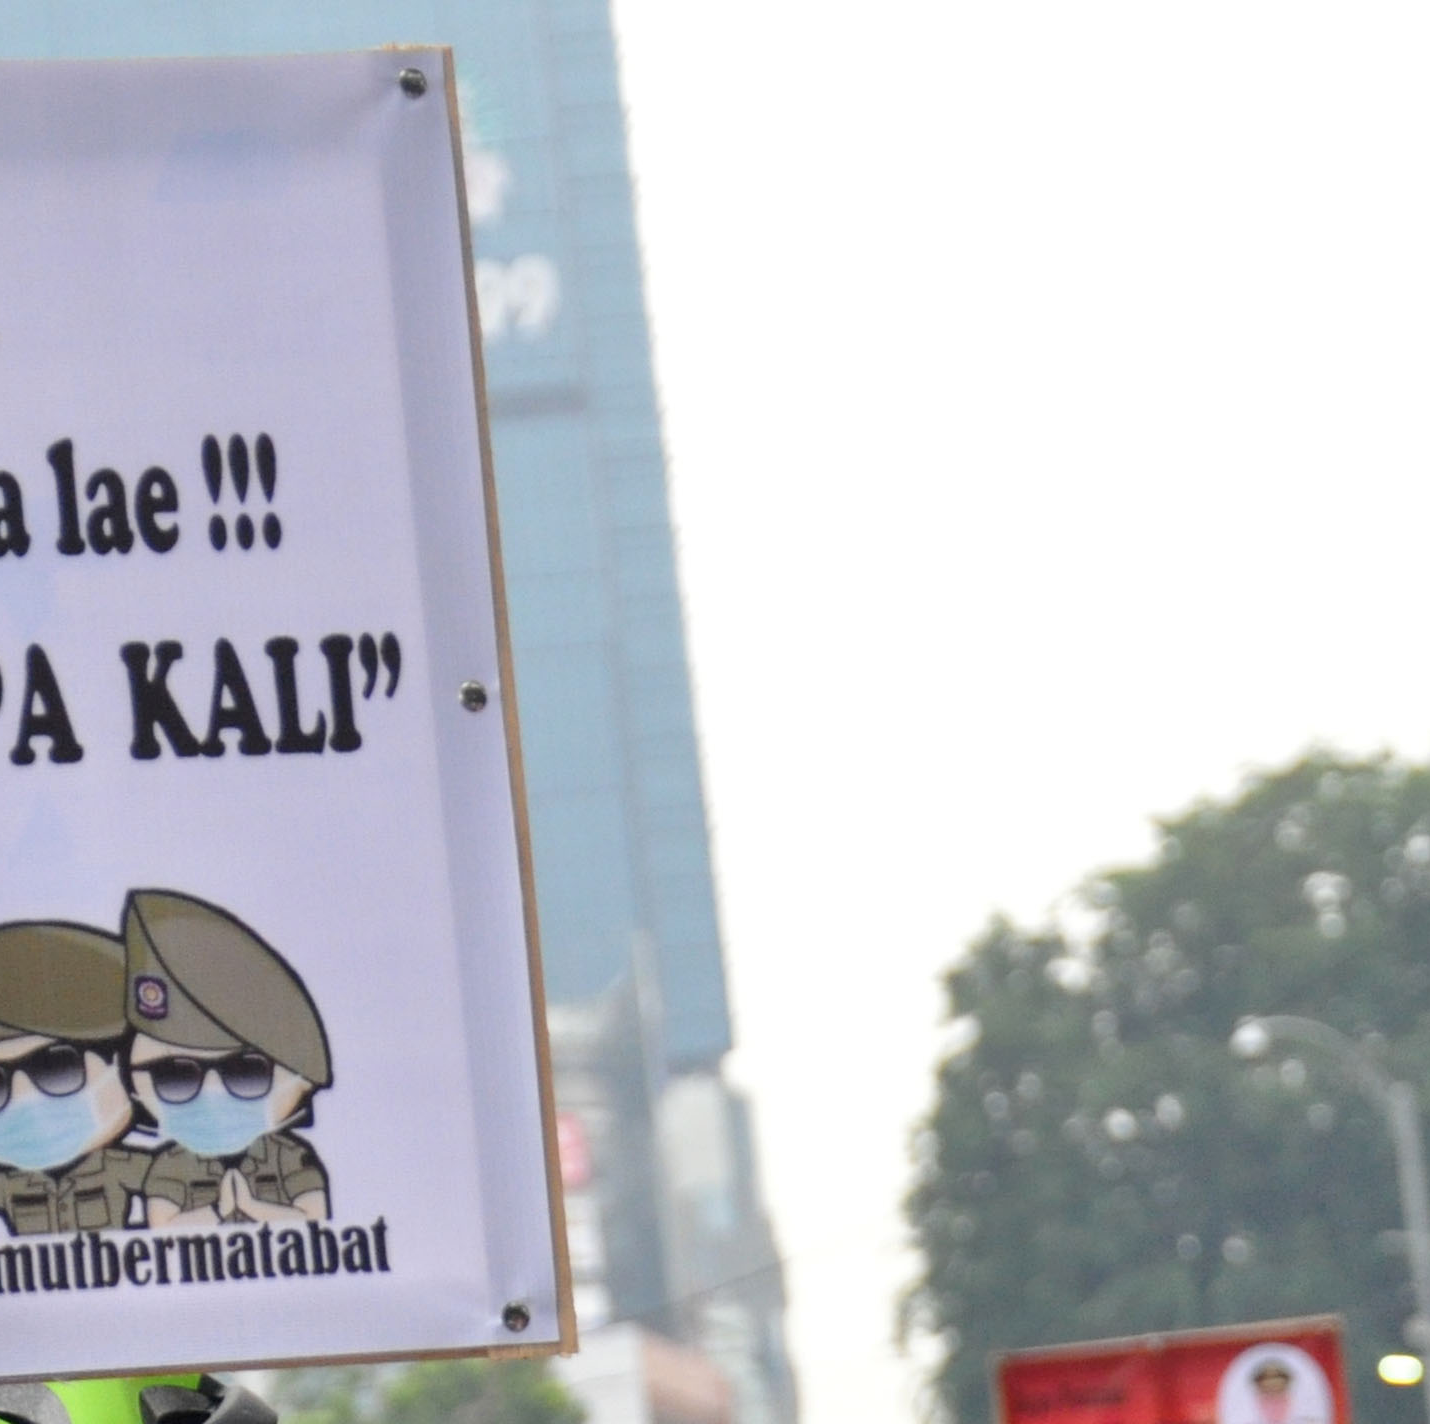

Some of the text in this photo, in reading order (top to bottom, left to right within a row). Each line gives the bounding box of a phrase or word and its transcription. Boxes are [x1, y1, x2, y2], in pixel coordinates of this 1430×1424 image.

[49, 439, 180, 556] lae
[202, 434, 283, 551] !!!
[121, 632, 402, 760] KALI”
